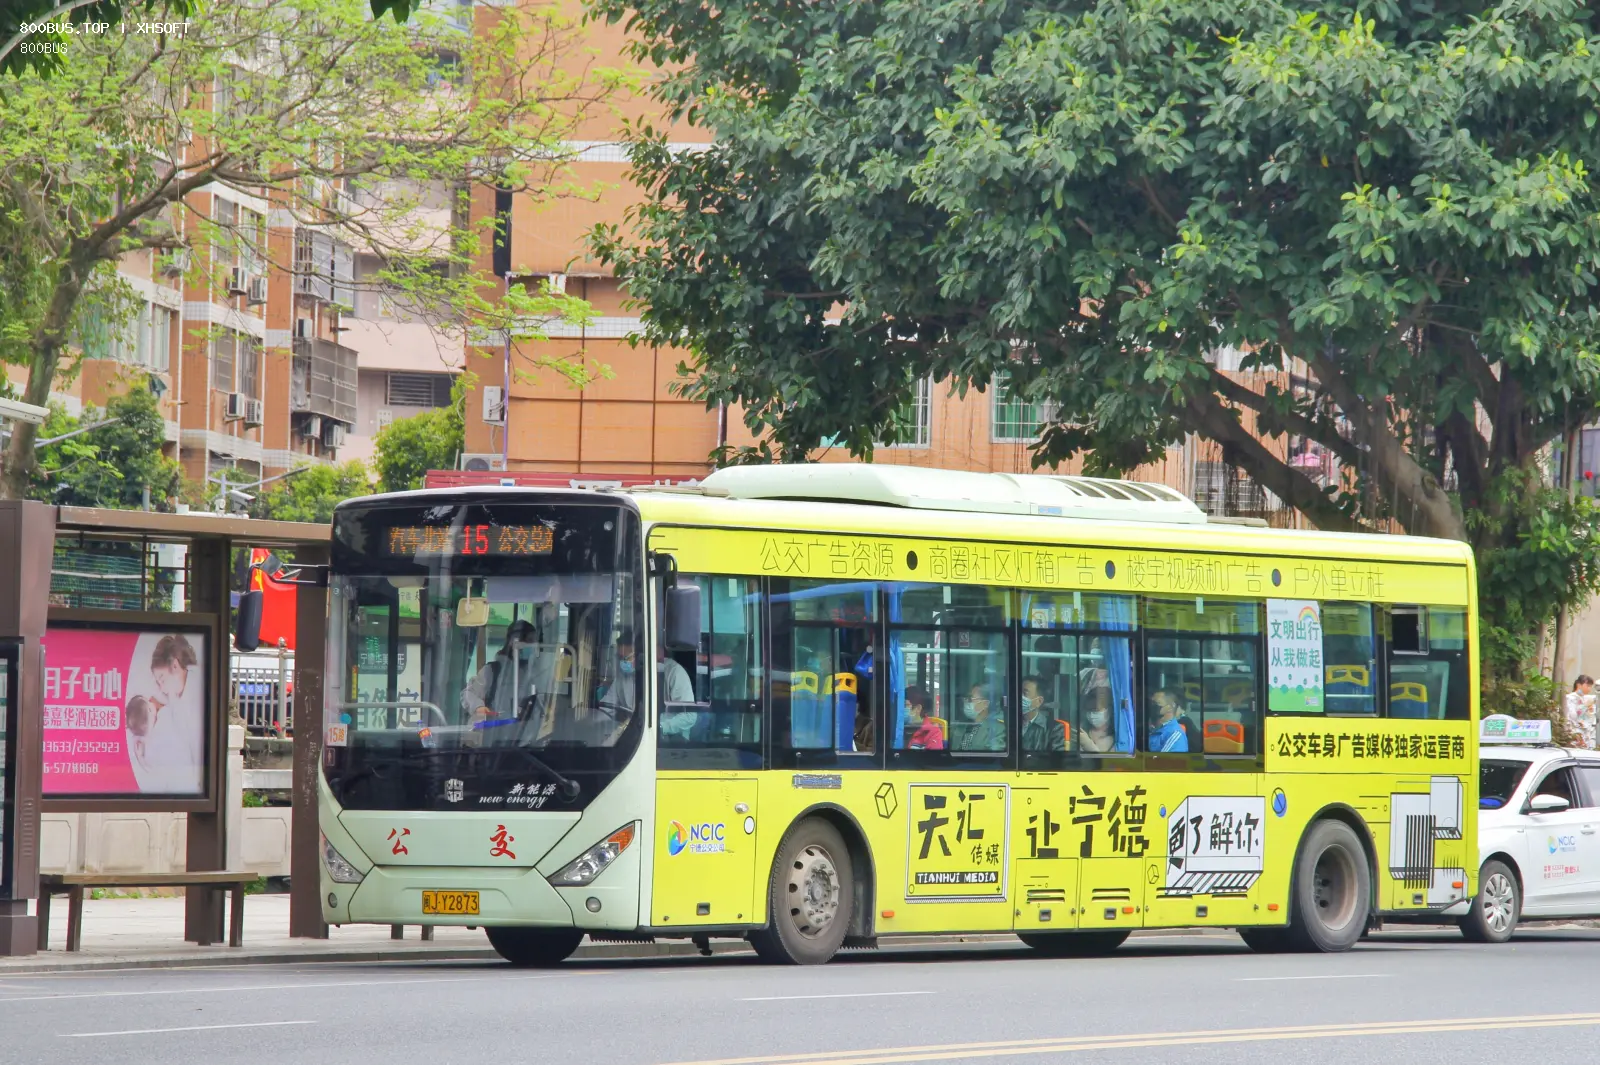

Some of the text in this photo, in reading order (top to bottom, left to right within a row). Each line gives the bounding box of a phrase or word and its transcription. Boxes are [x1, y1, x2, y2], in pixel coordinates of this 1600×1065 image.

[461, 525, 490, 555] 15
[760, 537, 1386, 598] 公交广告资源 商圈社区灯箱广告 楼宇视频机广告 户外单立柱
[1270, 619, 1320, 640] 文明出行
[1270, 647, 1320, 668] 从我做起
[43, 666, 122, 700] 月子中心
[1277, 732, 1465, 760] 公交车身广告媒体独家运营商
[508, 783, 557, 796] 新能源
[479, 795, 549, 809] new energy
[690, 823, 725, 841] NCIC
[917, 789, 986, 860] 天汇
[970, 843, 1000, 866] 传媒
[917, 872, 998, 884] TIANHUI MEDIA
